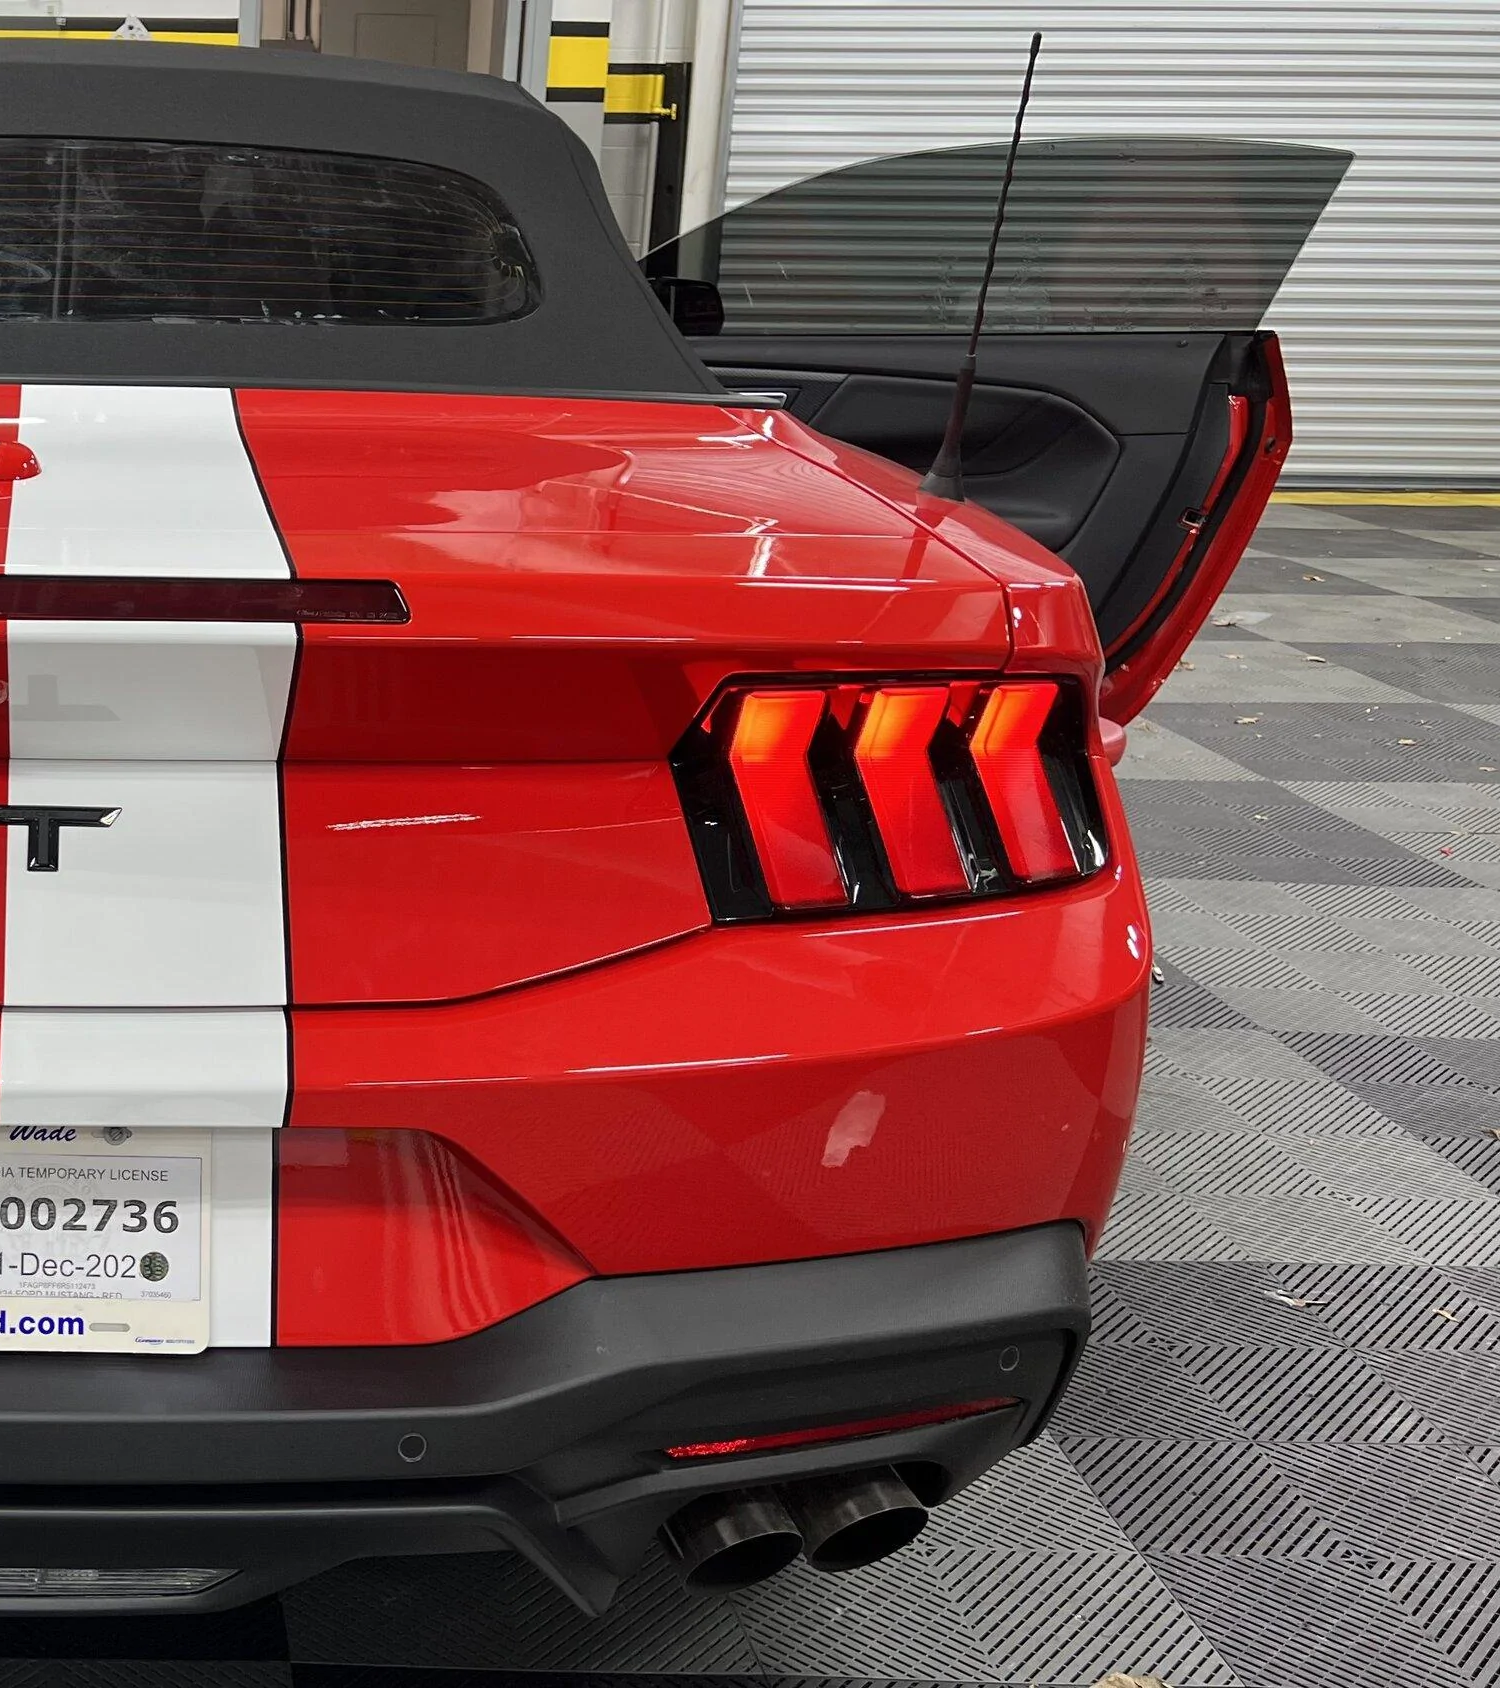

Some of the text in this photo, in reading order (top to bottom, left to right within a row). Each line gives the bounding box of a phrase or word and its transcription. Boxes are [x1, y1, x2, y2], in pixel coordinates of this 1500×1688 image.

[9, 1125, 77, 1142] Wade
[19, 1166, 107, 1180] TEMPORARY
[110, 1169, 169, 1182] LICENSE
